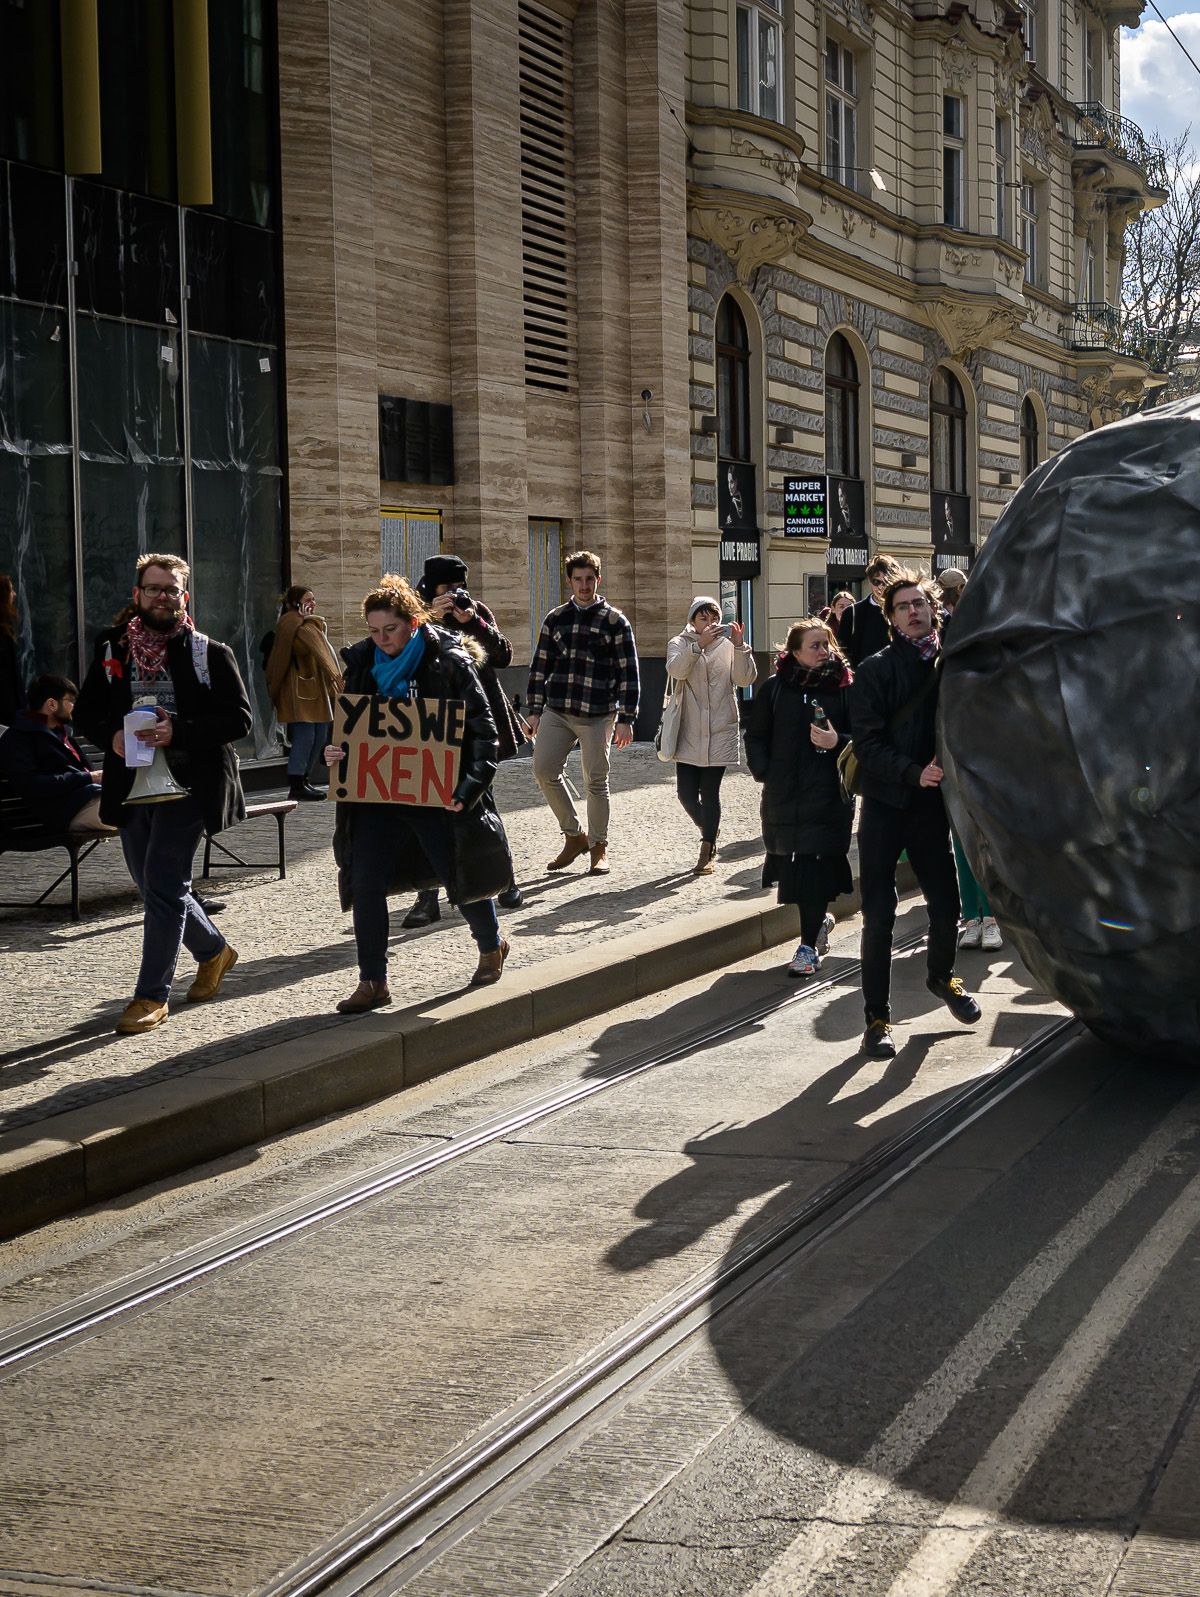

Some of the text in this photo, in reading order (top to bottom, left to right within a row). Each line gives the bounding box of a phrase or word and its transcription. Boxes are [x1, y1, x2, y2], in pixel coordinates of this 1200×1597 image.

[788, 481, 821, 490] SUPER
[785, 493, 825, 502] MARKET
[786, 517, 824, 525] CANNABIS
[337, 693, 465, 747] YES WE
